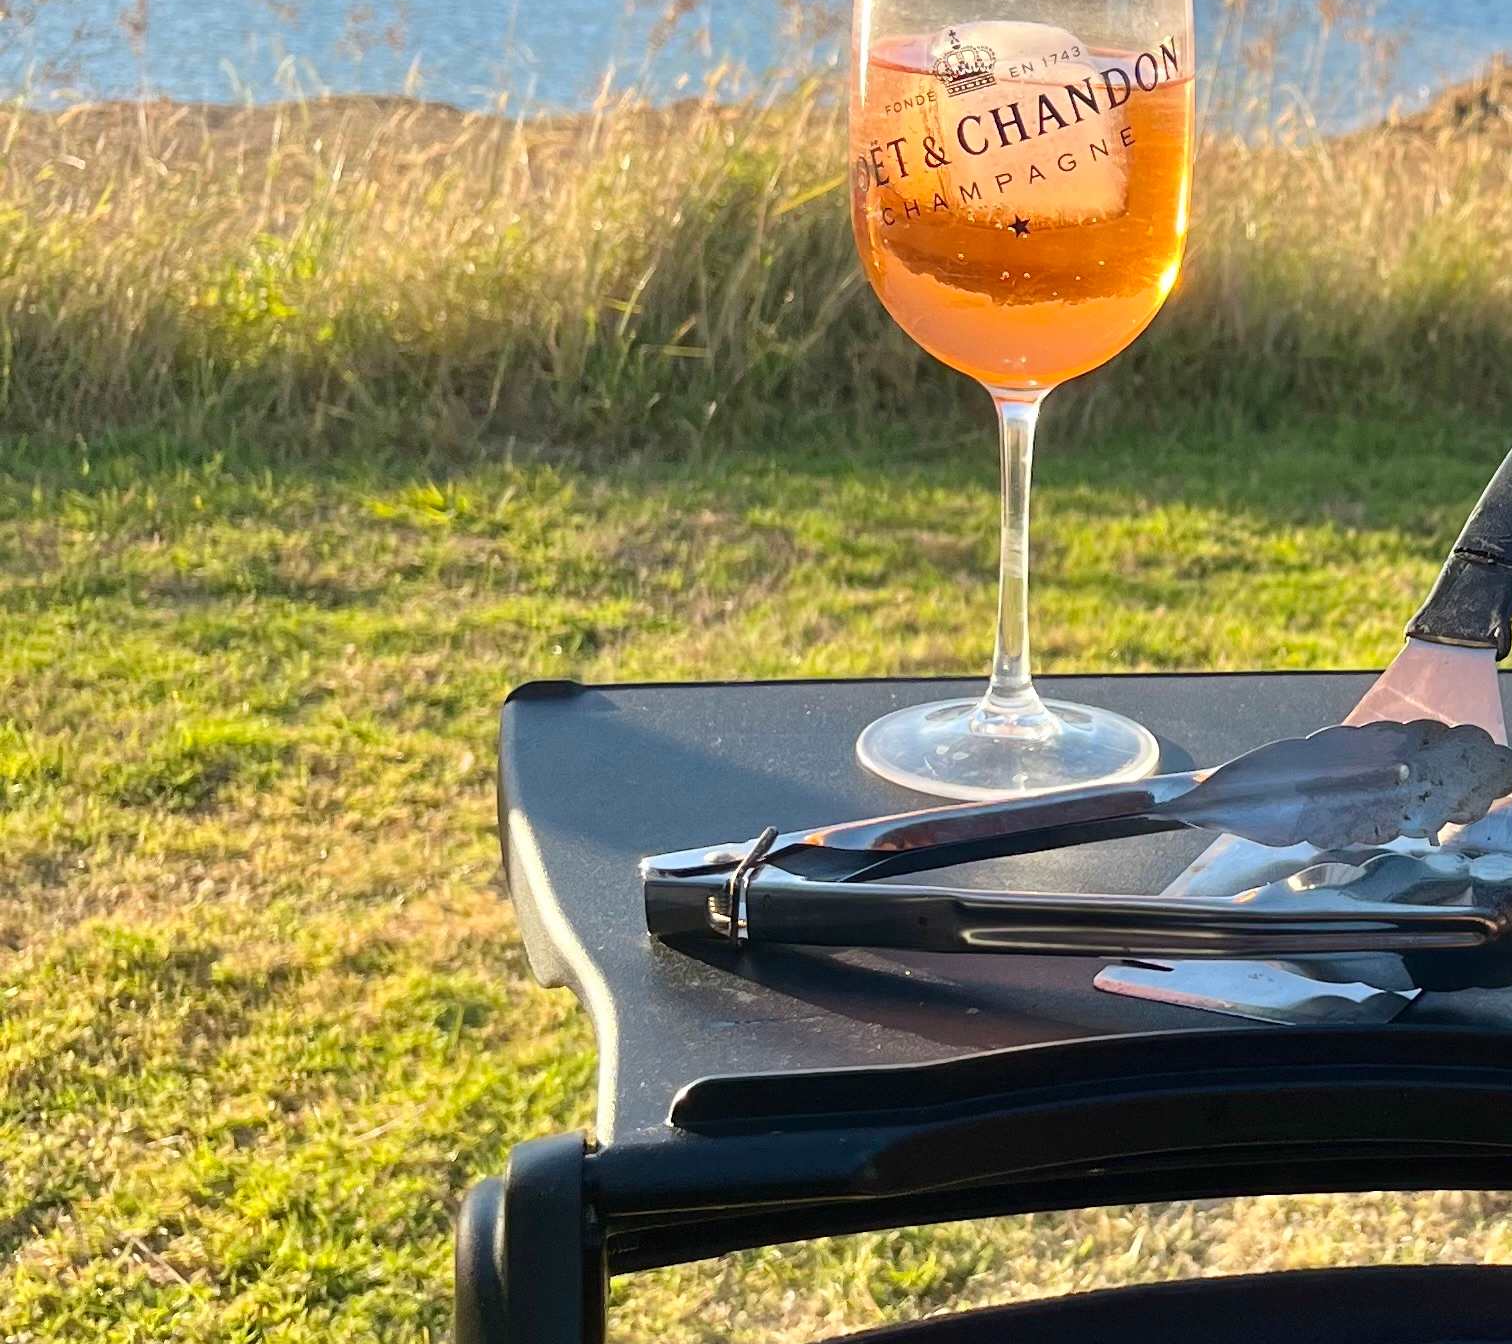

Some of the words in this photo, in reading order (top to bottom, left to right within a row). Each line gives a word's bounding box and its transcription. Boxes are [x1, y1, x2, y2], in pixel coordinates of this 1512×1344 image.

[1008, 63, 1034, 78] EN
[1042, 45, 1082, 67] 1743
[855, 137, 910, 193] OËT
[922, 135, 952, 169] &
[956, 35, 1180, 156] CHANDON
[881, 126, 1136, 226] CHAMPAGNE
